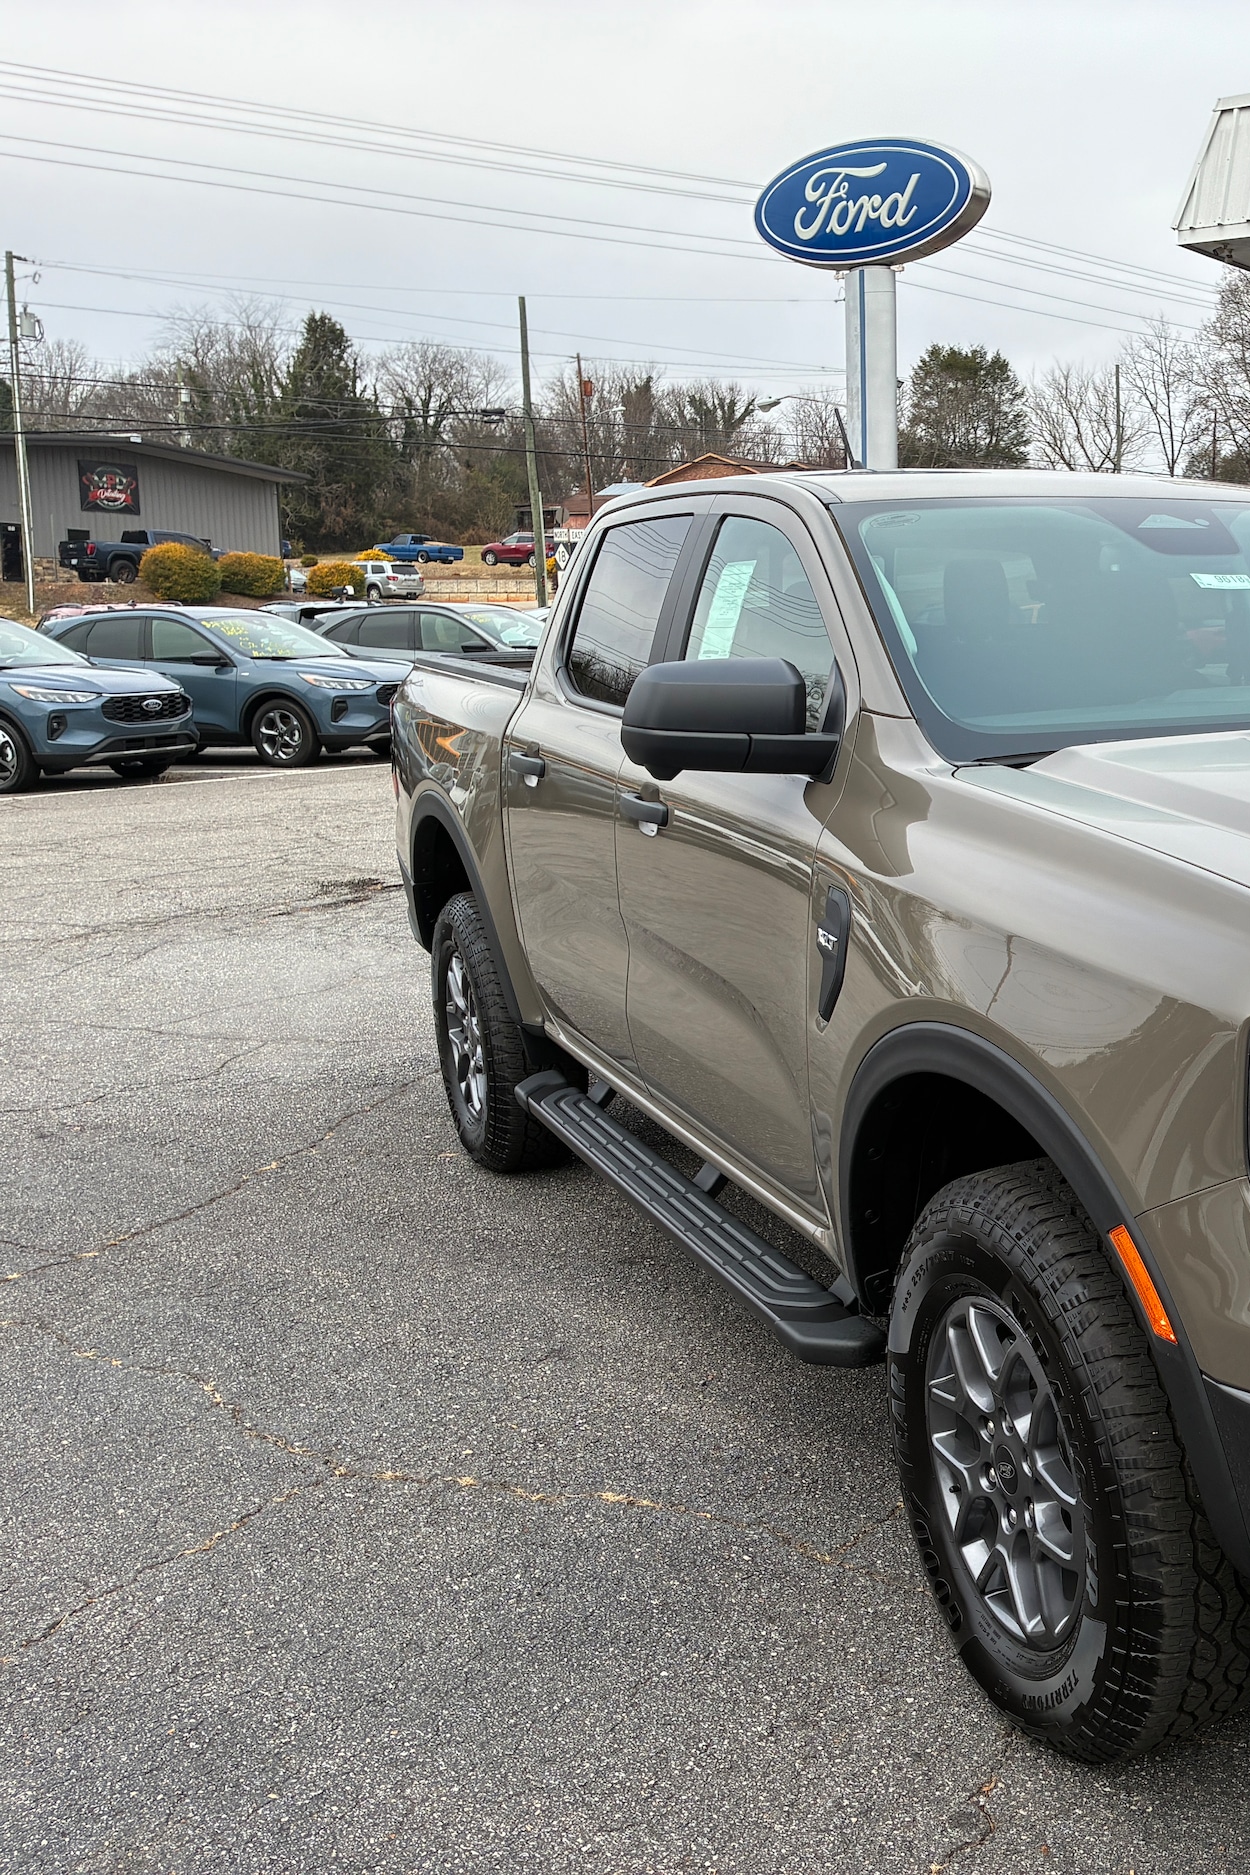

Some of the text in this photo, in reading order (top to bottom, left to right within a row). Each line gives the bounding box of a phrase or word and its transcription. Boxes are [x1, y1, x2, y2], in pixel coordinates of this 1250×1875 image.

[793, 162, 921, 241] Ford
[554, 531, 567, 539] NORTH
[558, 550, 567, 563] 18
